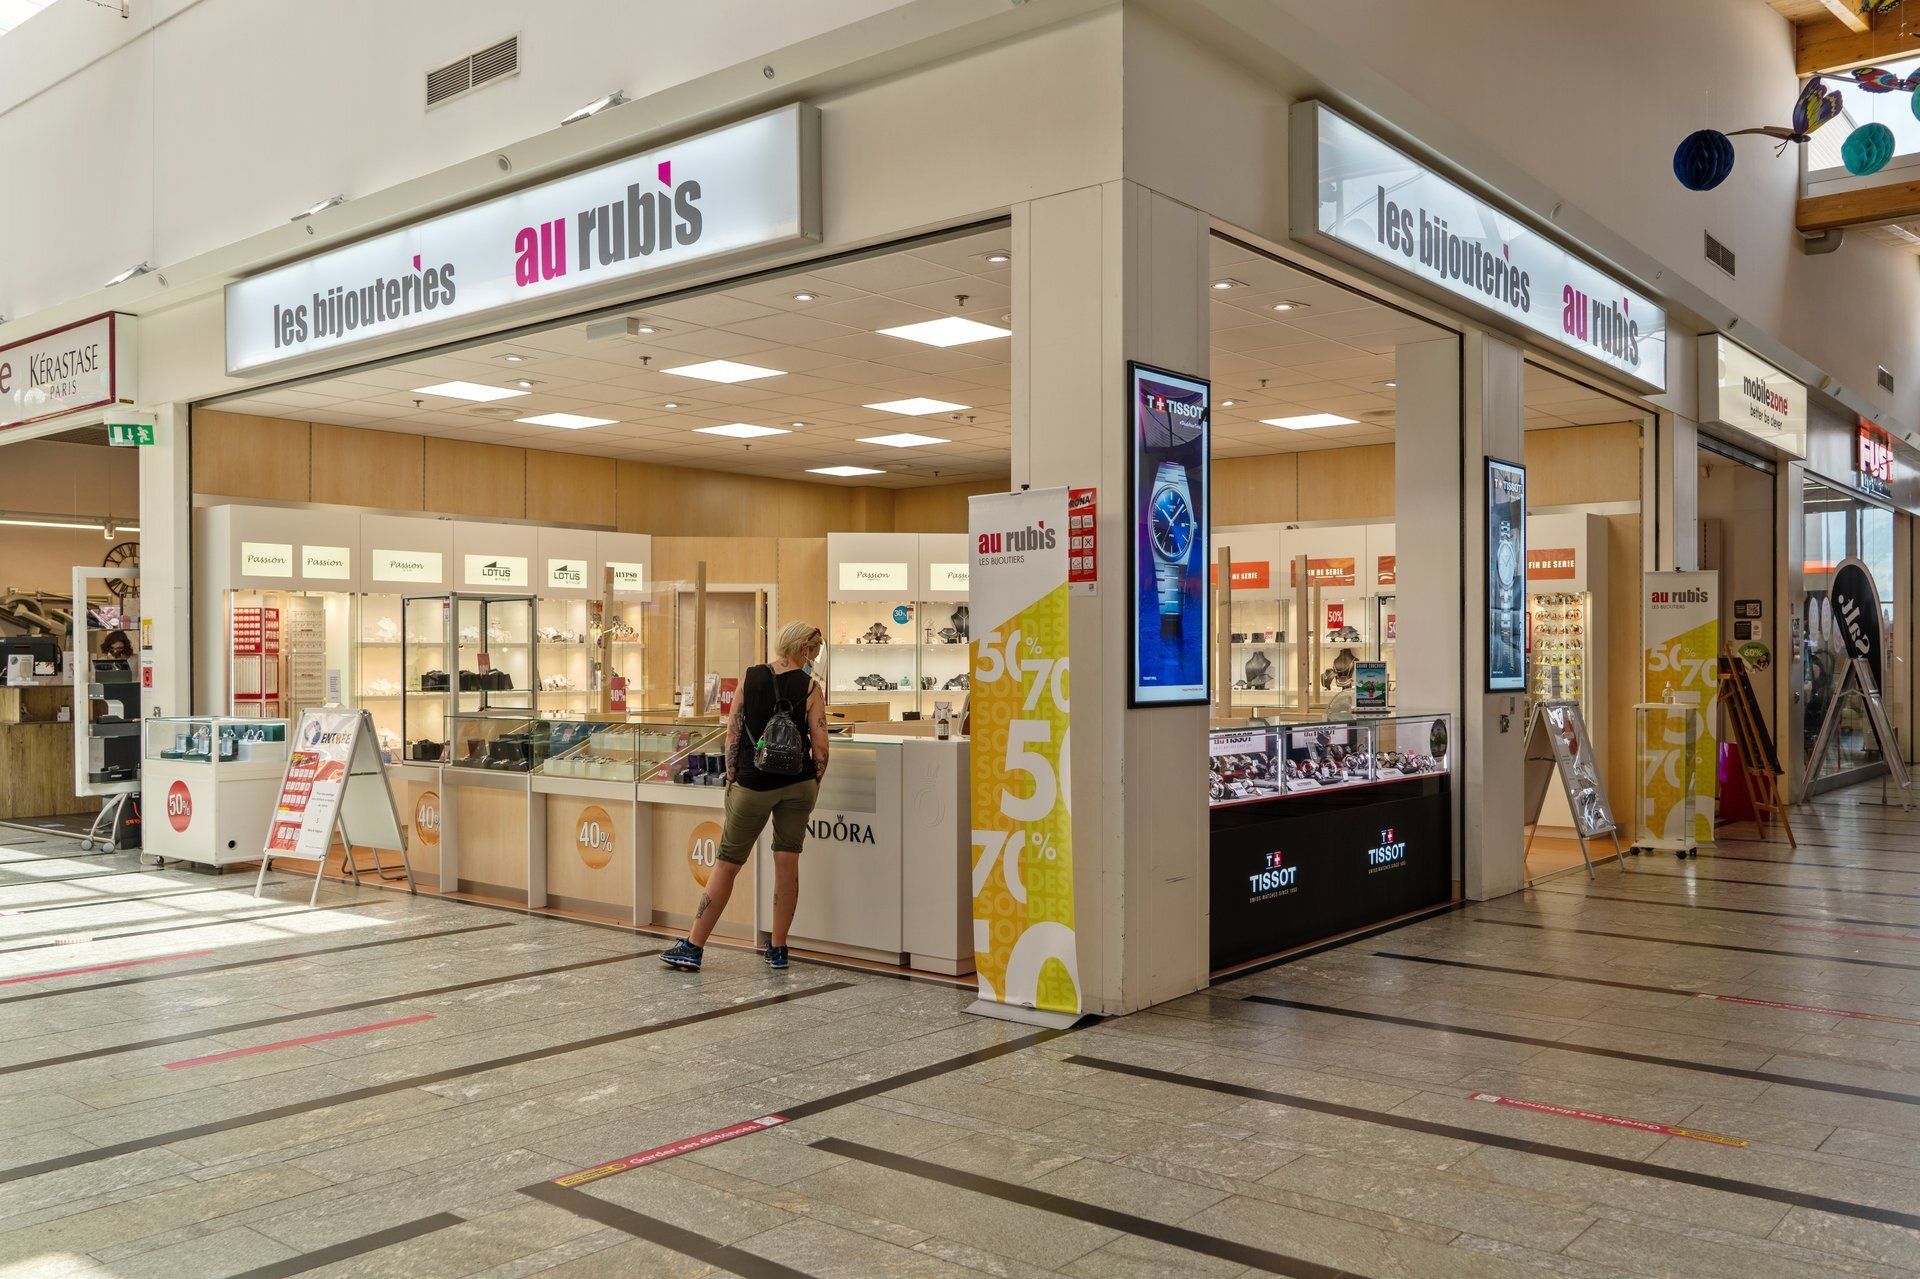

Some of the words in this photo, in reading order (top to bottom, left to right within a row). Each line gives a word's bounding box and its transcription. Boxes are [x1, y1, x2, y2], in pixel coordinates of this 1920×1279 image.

[515, 218, 567, 287] au
[578, 160, 703, 271] rubis
[1377, 185, 1414, 258] les
[1419, 208, 1530, 313] bijouteries
[274, 304, 308, 348] les
[313, 254, 456, 338] bijouteries
[1562, 284, 1588, 342] au
[1592, 297, 1639, 366] rubis
[30, 344, 98, 387] KÉRASTASE
[50, 380, 77, 399] PARIS
[1743, 376, 1788, 416] mobilezone
[1167, 399, 1204, 419] TISSOT
[1503, 481, 1521, 492] TISSOT
[978, 533, 1002, 554] au
[1006, 521, 1056, 552] rubis
[247, 555, 286, 564] Passion
[307, 558, 344, 567] Passion
[390, 560, 425, 570] Passion
[979, 557, 990, 566] LES
[991, 555, 1025, 565] BIJOUTIERS
[1542, 560, 1551, 568] DE
[1553, 560, 1575, 568] SERIE
[482, 568, 511, 577] LOTUS
[553, 572, 580, 580] LOTUS
[856, 571, 890, 579] Passion
[1651, 591, 1669, 603] au
[1672, 587, 1709, 603] rubis
[1328, 611, 1344, 622] 50%
[169, 793, 190, 816] 50%
[579, 820, 613, 852] 40%
[1368, 843, 1405, 864] TISSOT
[1249, 866, 1297, 893] TISSOT
[629, 1148, 676, 1164] Garder
[678, 1142, 700, 1151] ses
[700, 1124, 761, 1145] distances.
